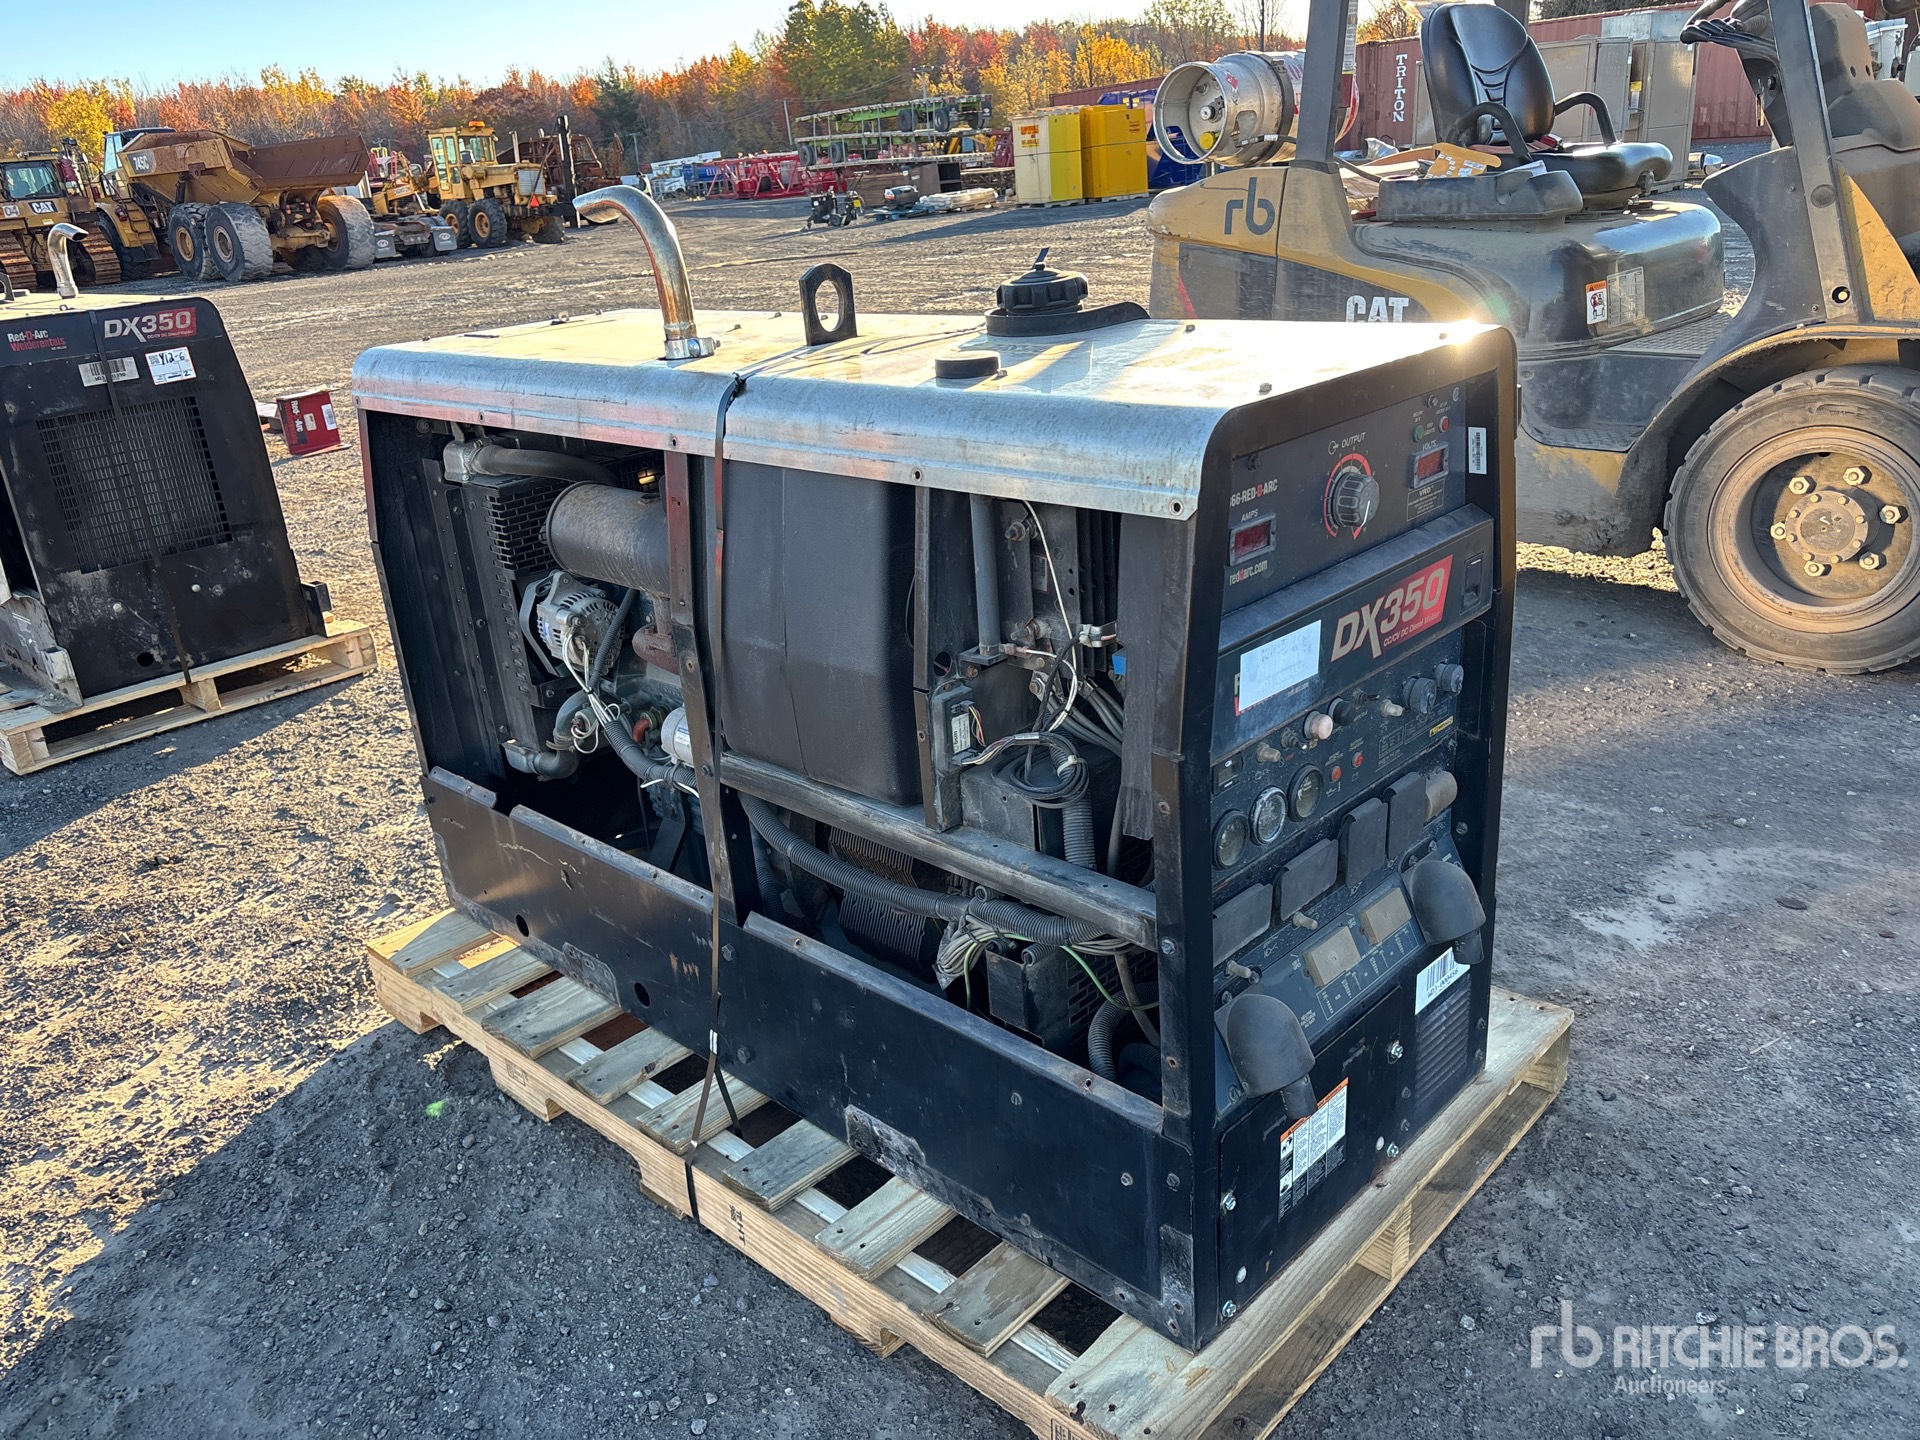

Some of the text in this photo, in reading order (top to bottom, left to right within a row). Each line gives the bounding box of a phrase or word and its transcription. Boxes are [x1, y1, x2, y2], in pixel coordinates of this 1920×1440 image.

[1393, 54, 1408, 122] TRITON
[32, 202, 56, 213] CAT
[1224, 177, 1275, 235] rb
[1346, 295, 1409, 322] CAT
[104, 311, 192, 342] DX350
[1342, 432, 1366, 448] OUTPUT
[1422, 440, 1437, 451] VOLTS
[1230, 479, 1278, 508] 66-RED-D-ARC
[1241, 509, 1259, 522] AMPS
[1229, 560, 1268, 586] reddarc.com
[1331, 567, 1445, 662] DX350
[1401, 627, 1409, 638] DC
[1409, 619, 1424, 633] Diesel
